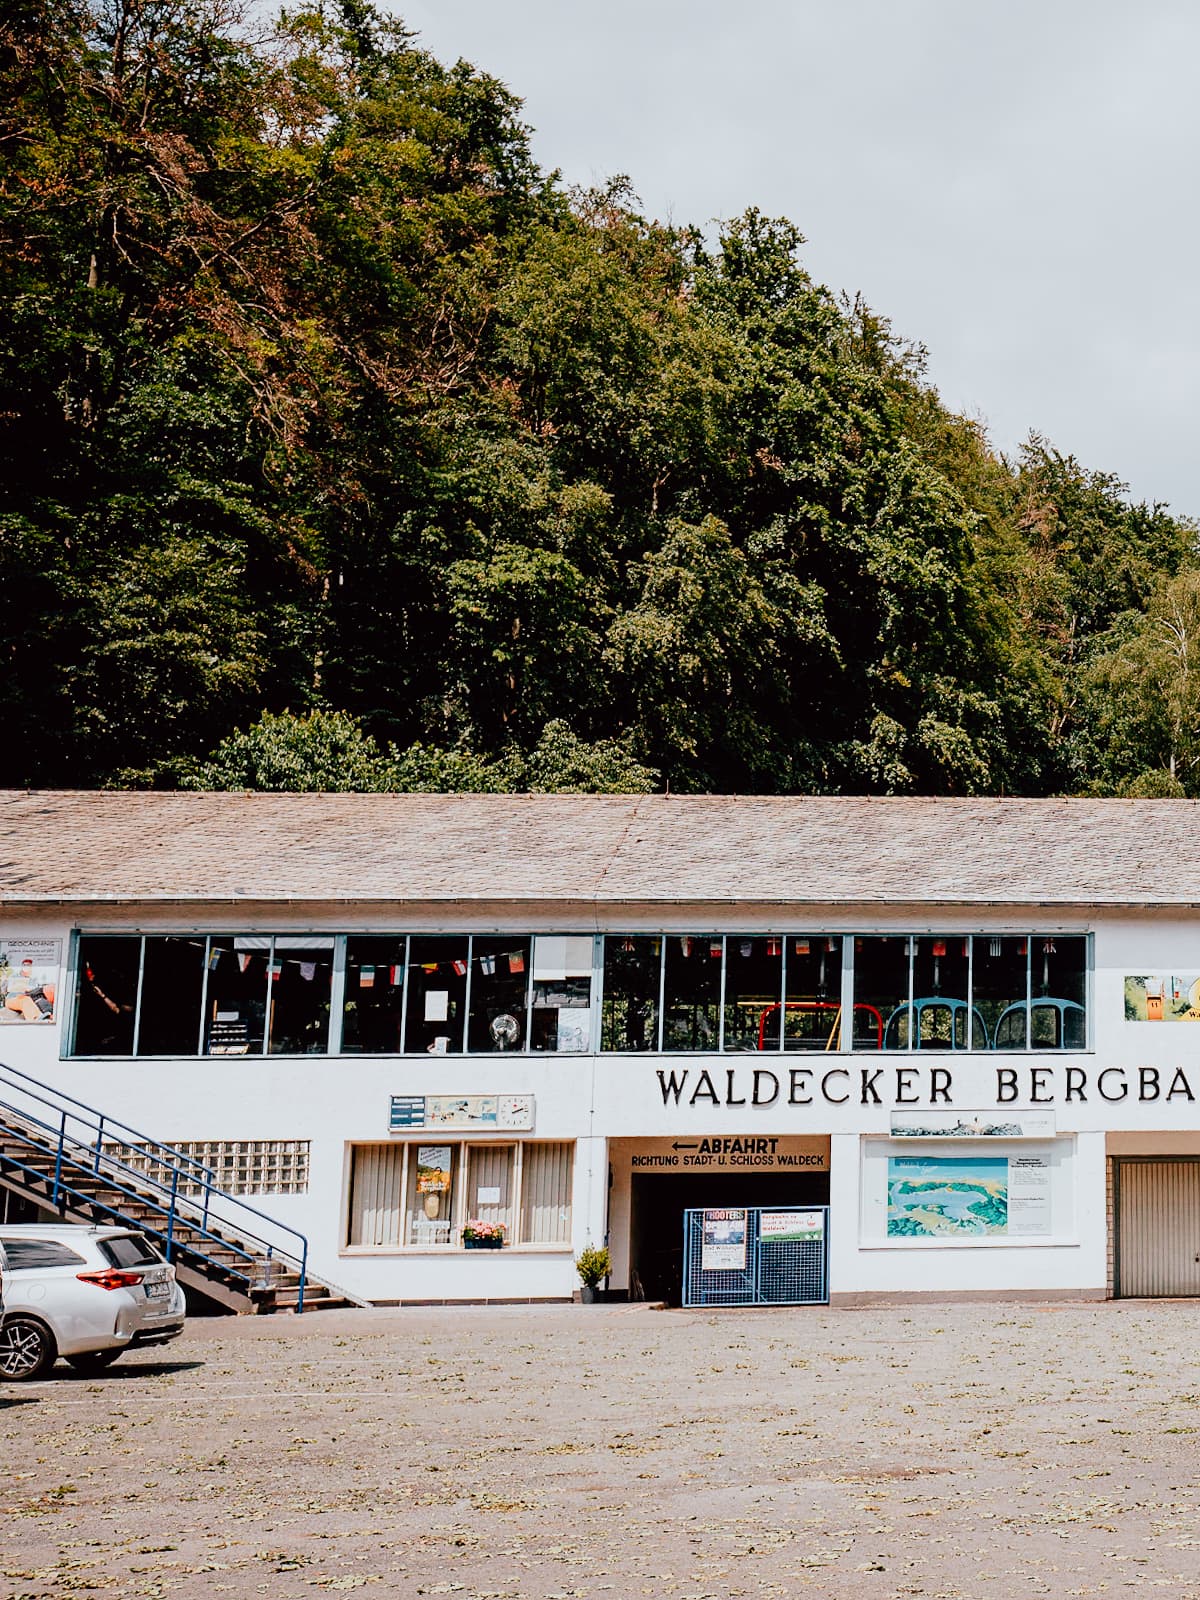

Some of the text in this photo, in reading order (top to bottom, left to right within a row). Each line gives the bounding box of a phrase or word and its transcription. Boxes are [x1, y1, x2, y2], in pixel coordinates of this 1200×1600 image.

[656, 1069, 952, 1105] WALDECKER
[699, 1138, 779, 1154] ABFAHRT
[631, 1155, 825, 1167] RICHTUNG STADT- U. SCHLOSS WALDECK
